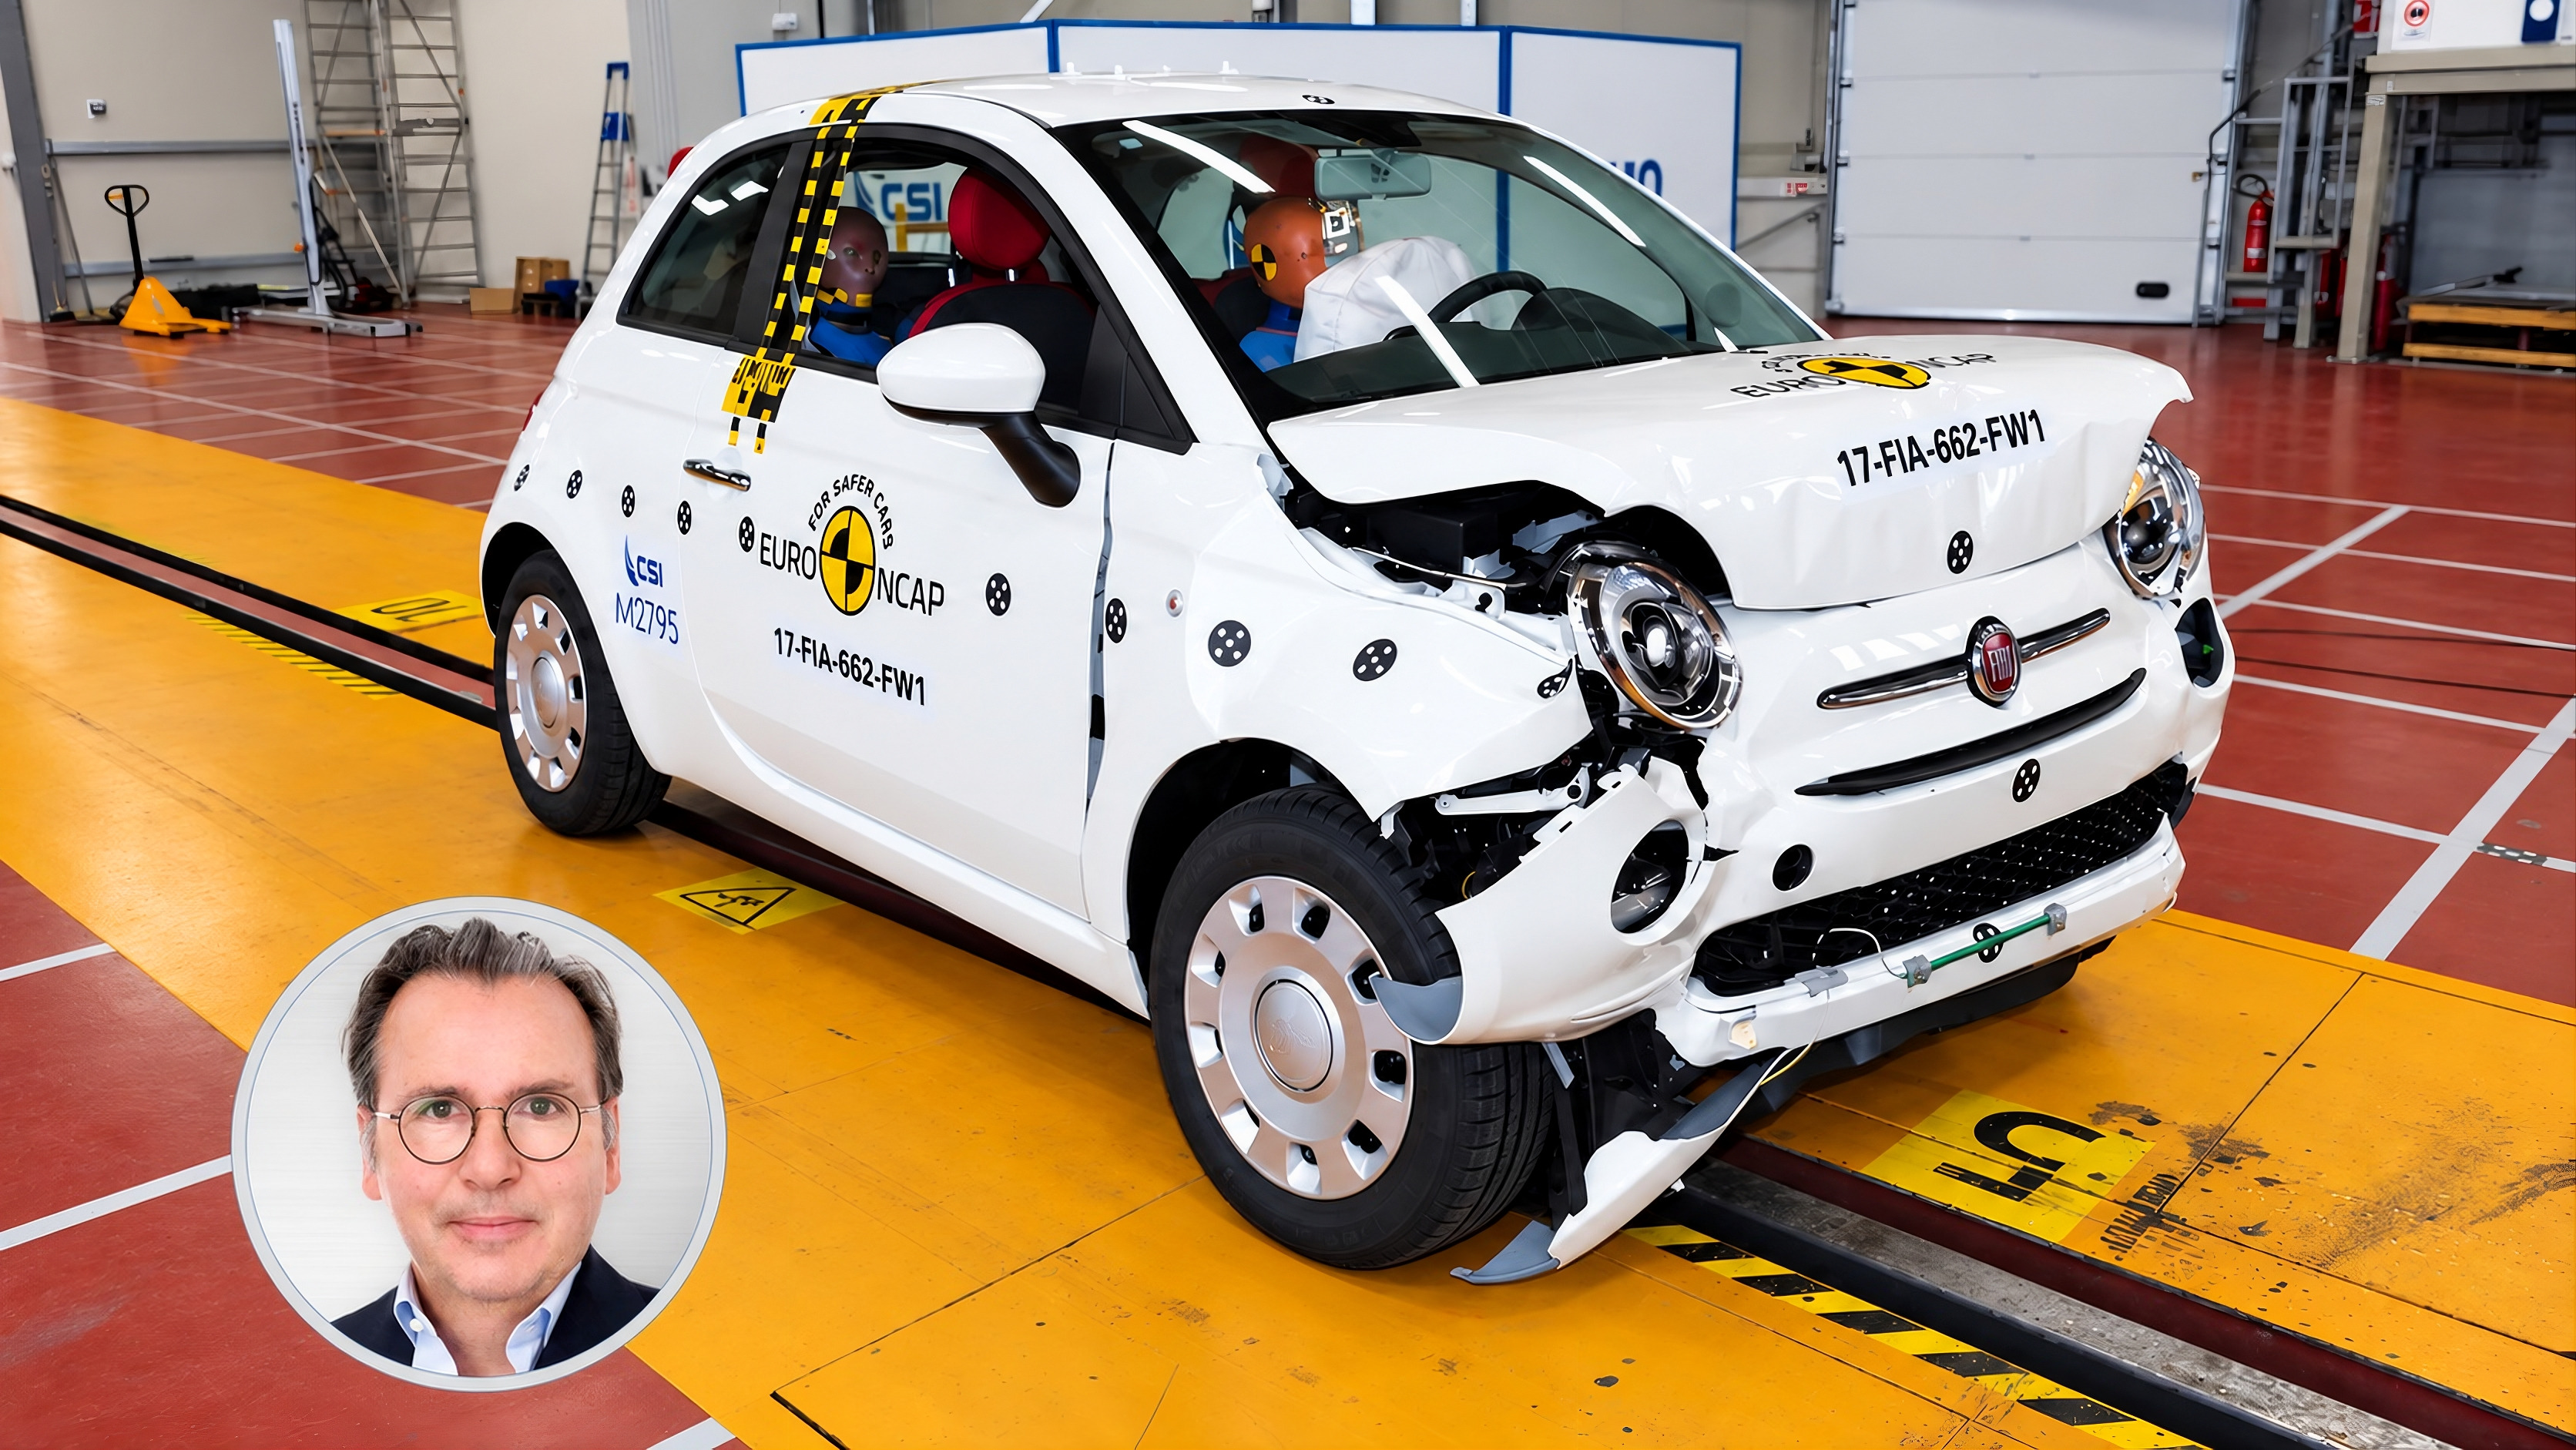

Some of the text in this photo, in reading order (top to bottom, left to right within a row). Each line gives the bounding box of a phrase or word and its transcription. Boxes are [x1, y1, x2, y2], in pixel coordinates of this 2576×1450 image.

[880, 182, 942, 221] CSI
[1730, 374, 1846, 398] EURO
[1837, 408, 2045, 487] 17-FIA-662-FW1
[808, 473, 894, 550] FOR SAFER CARS
[636, 555, 663, 588] CSI
[760, 532, 945, 616] EURO NCAP
[615, 592, 679, 645] M2795
[774, 627, 924, 707] 17-FIA-662-FW1
